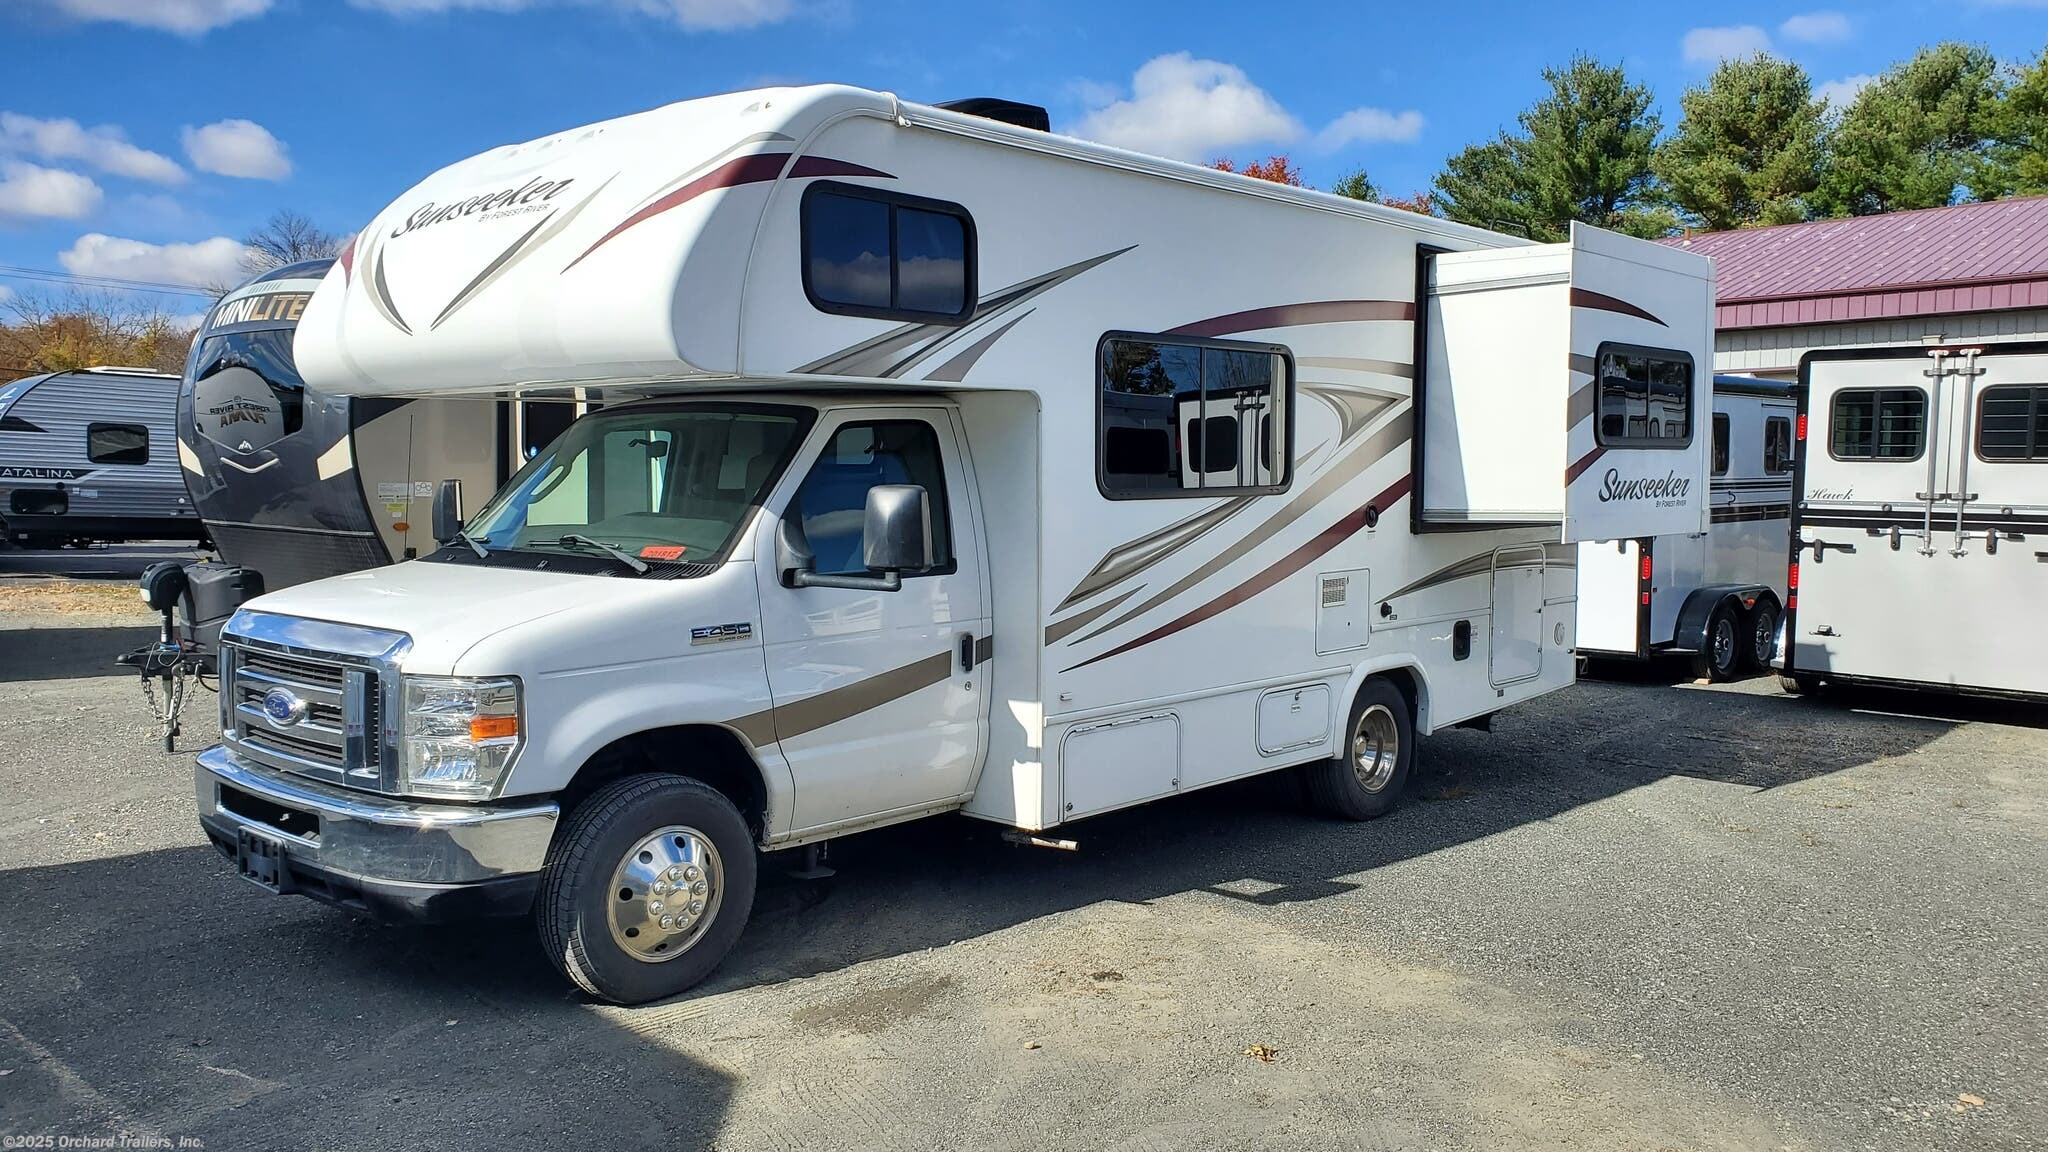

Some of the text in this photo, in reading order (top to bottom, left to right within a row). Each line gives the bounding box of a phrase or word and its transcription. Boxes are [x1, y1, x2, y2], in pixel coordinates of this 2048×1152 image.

[391, 176, 575, 238] Sunseeker
[491, 208, 522, 220] FOREST
[523, 204, 550, 214] RIVER
[1599, 467, 1690, 502] Sunseeker
[1807, 488, 1854, 499] Hawk
